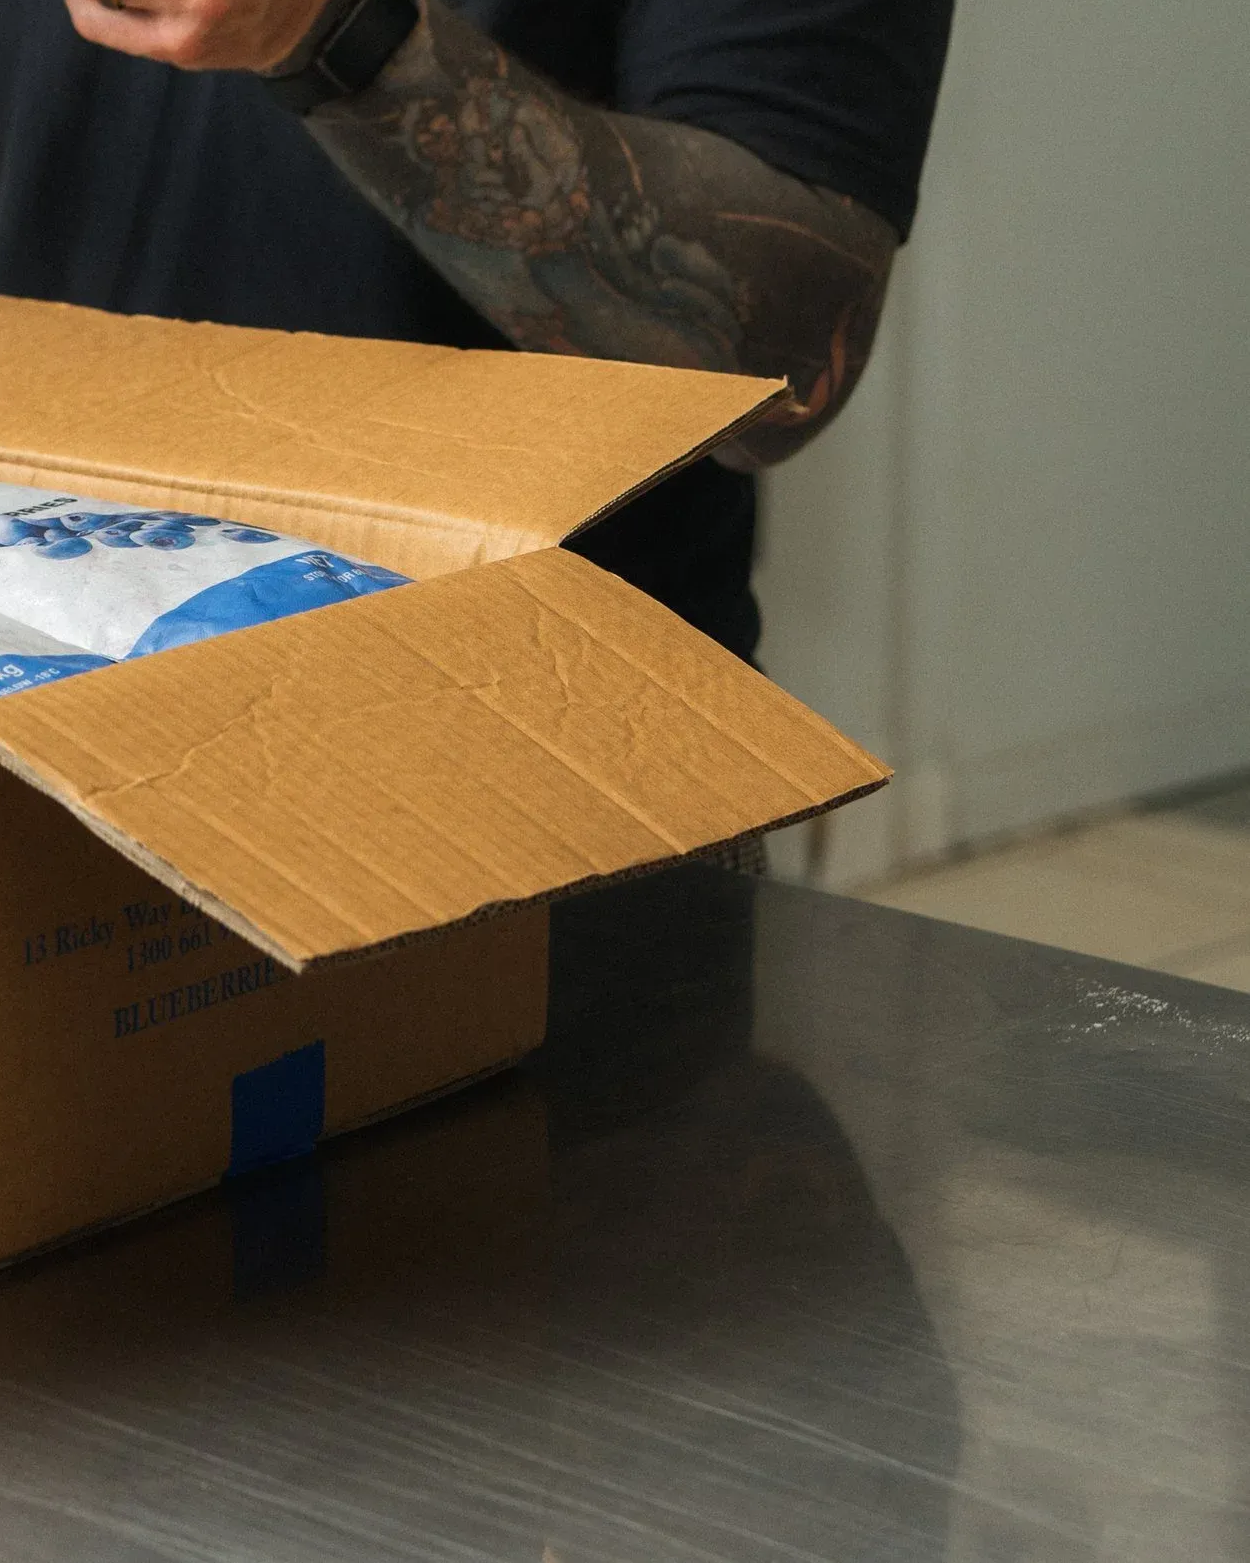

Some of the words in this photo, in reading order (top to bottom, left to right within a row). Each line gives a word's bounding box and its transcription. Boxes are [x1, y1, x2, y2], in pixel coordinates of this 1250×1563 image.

[23, 935, 47, 967] 13
[55, 916, 115, 957] Ricky
[123, 900, 173, 931] Way
[126, 935, 173, 973] 1300
[179, 919, 214, 954] 661
[112, 956, 291, 1038] BLUEBERRIE
